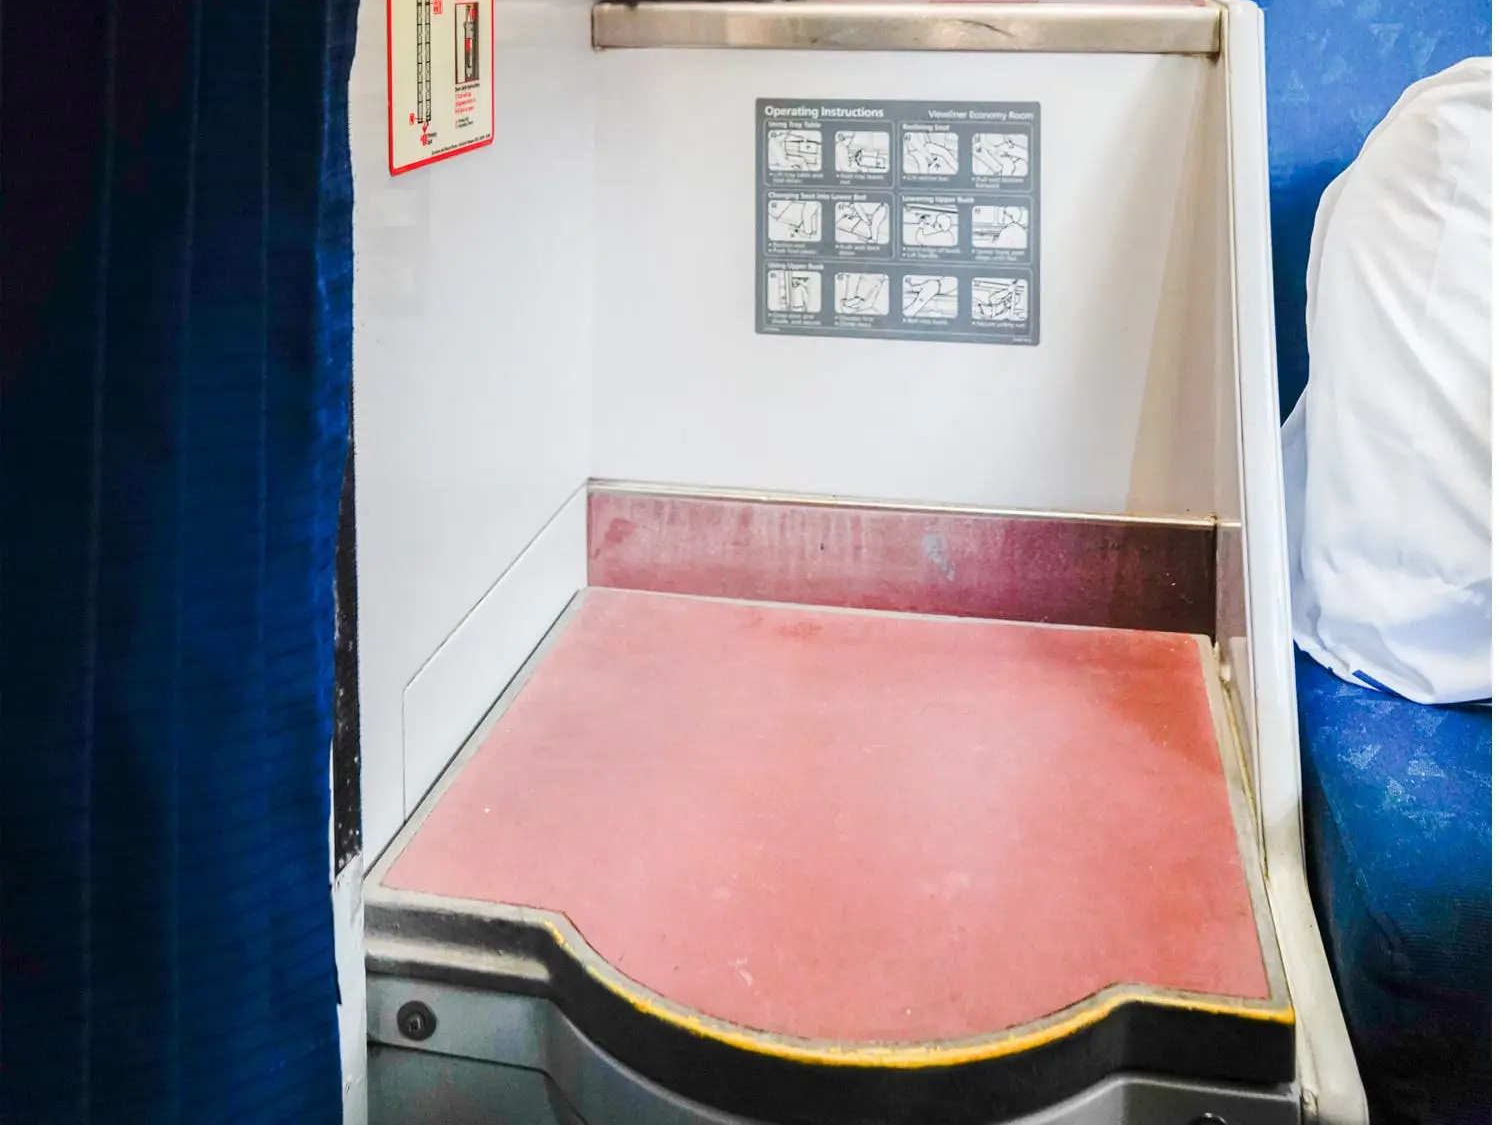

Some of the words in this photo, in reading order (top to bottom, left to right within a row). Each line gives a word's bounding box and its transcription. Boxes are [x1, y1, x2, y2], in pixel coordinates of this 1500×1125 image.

[765, 106, 819, 118] Operating
[821, 106, 884, 117] Instructions
[928, 110, 967, 118] Viewliner
[969, 110, 1007, 121] Economy
[1008, 111, 1034, 120] Room
